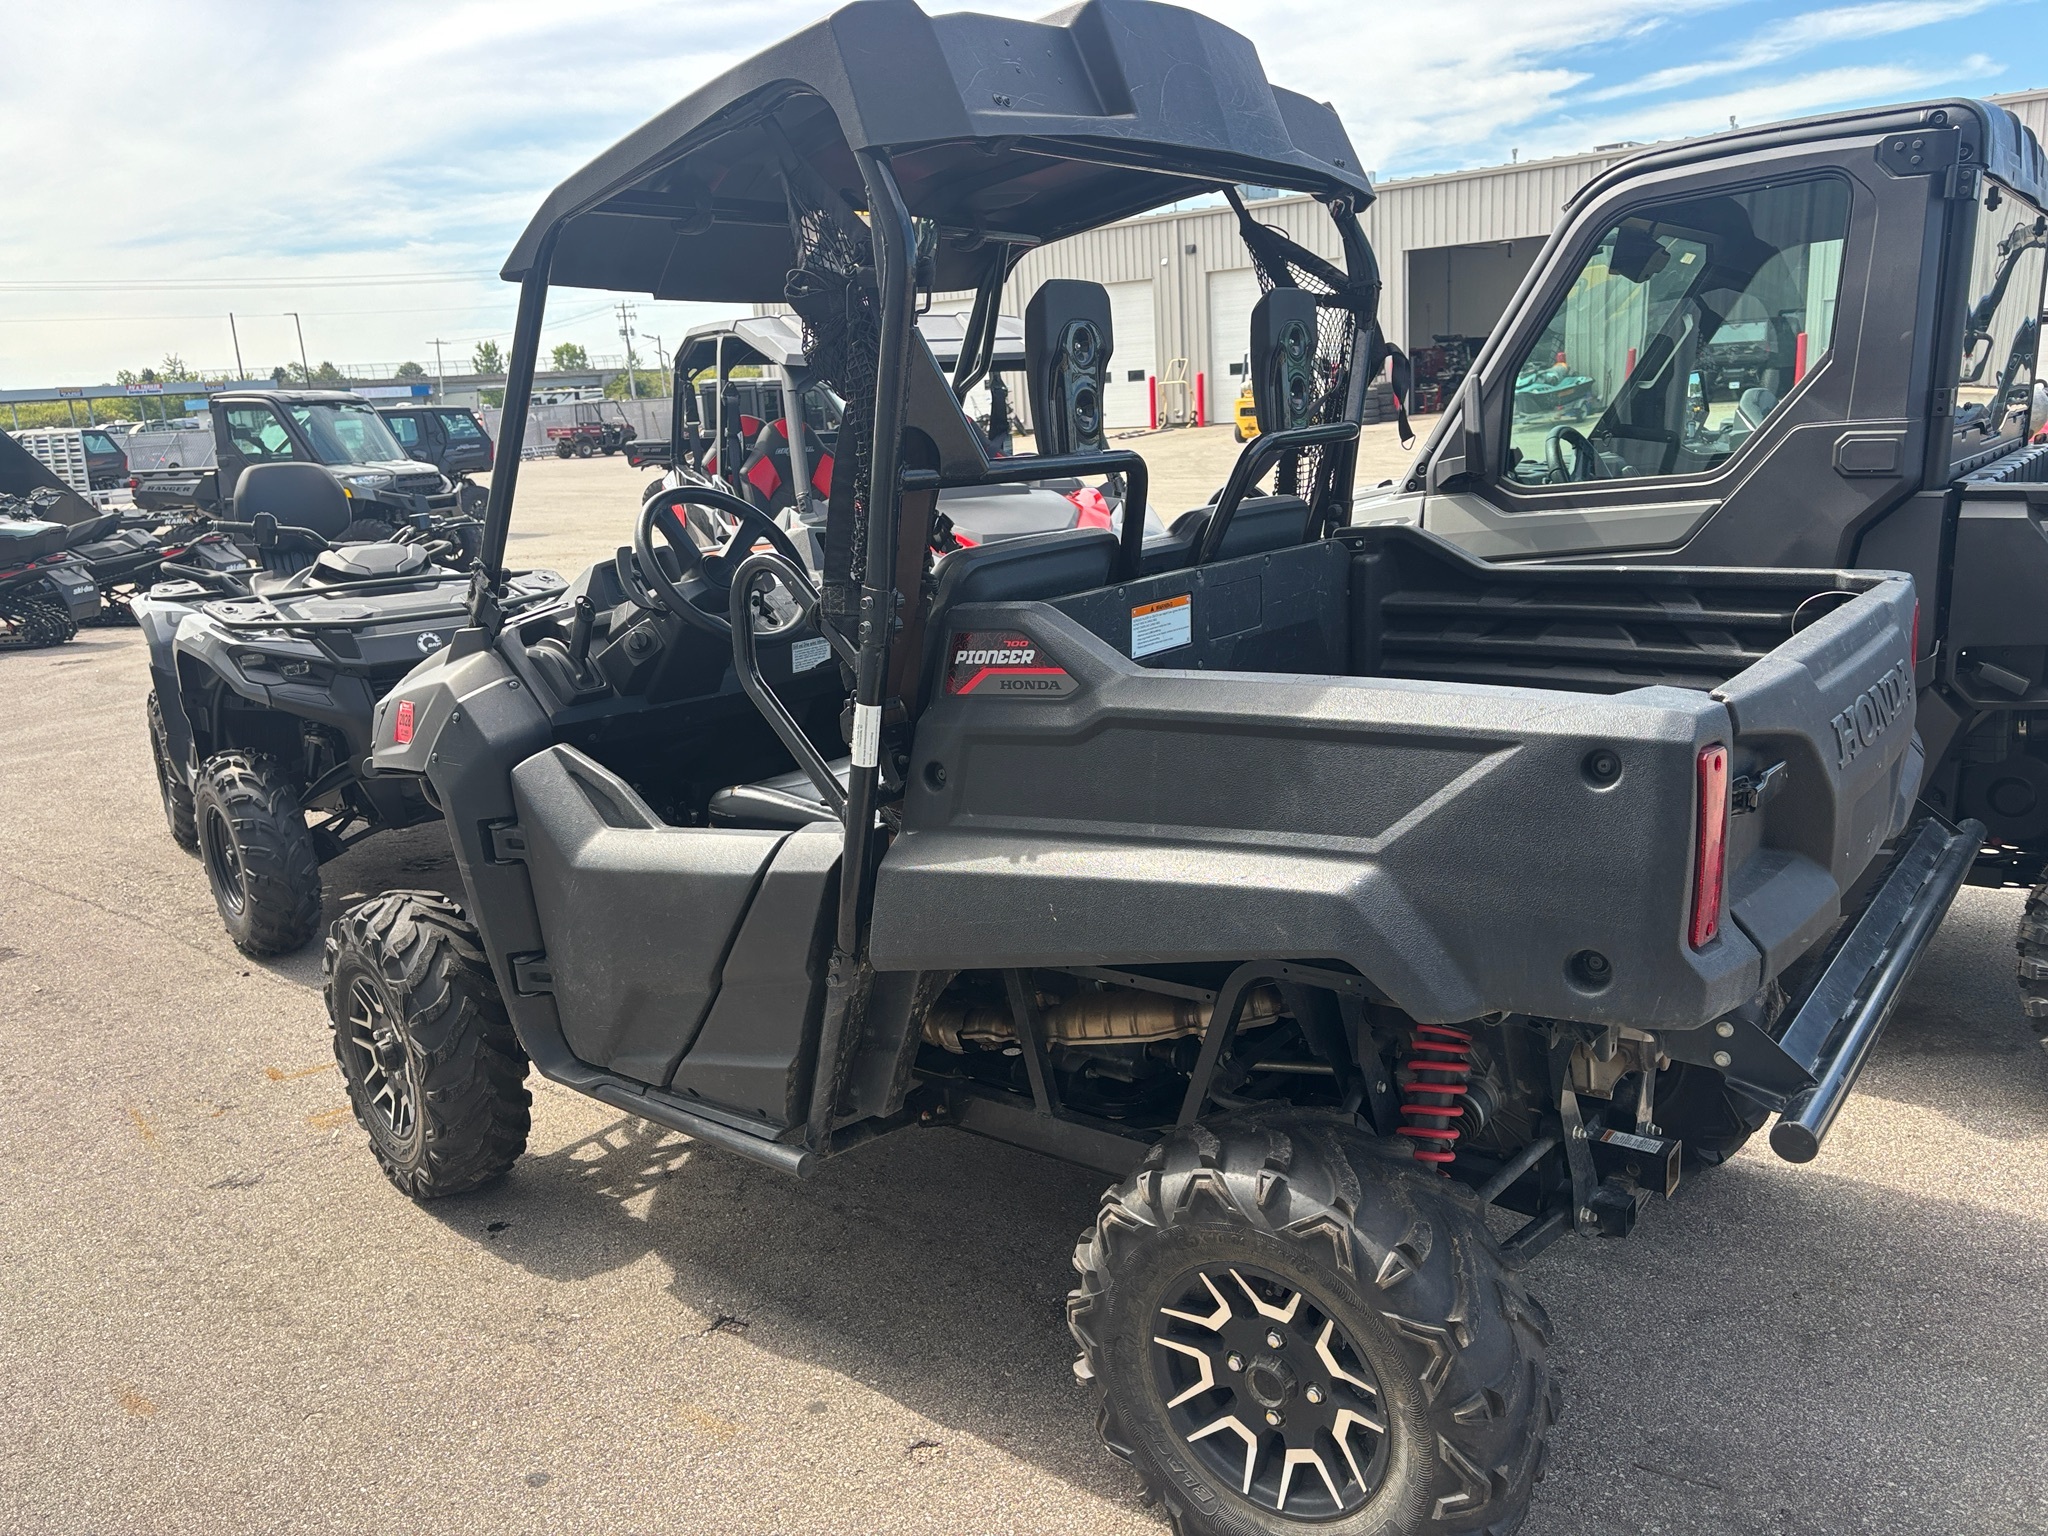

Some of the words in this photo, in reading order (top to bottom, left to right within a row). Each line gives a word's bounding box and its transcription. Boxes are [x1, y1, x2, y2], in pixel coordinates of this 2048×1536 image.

[1003, 640, 1029, 648] 700
[954, 649, 1036, 665] PIONEER
[999, 680, 1062, 691] HONDA
[1830, 658, 1911, 770] HONDA
